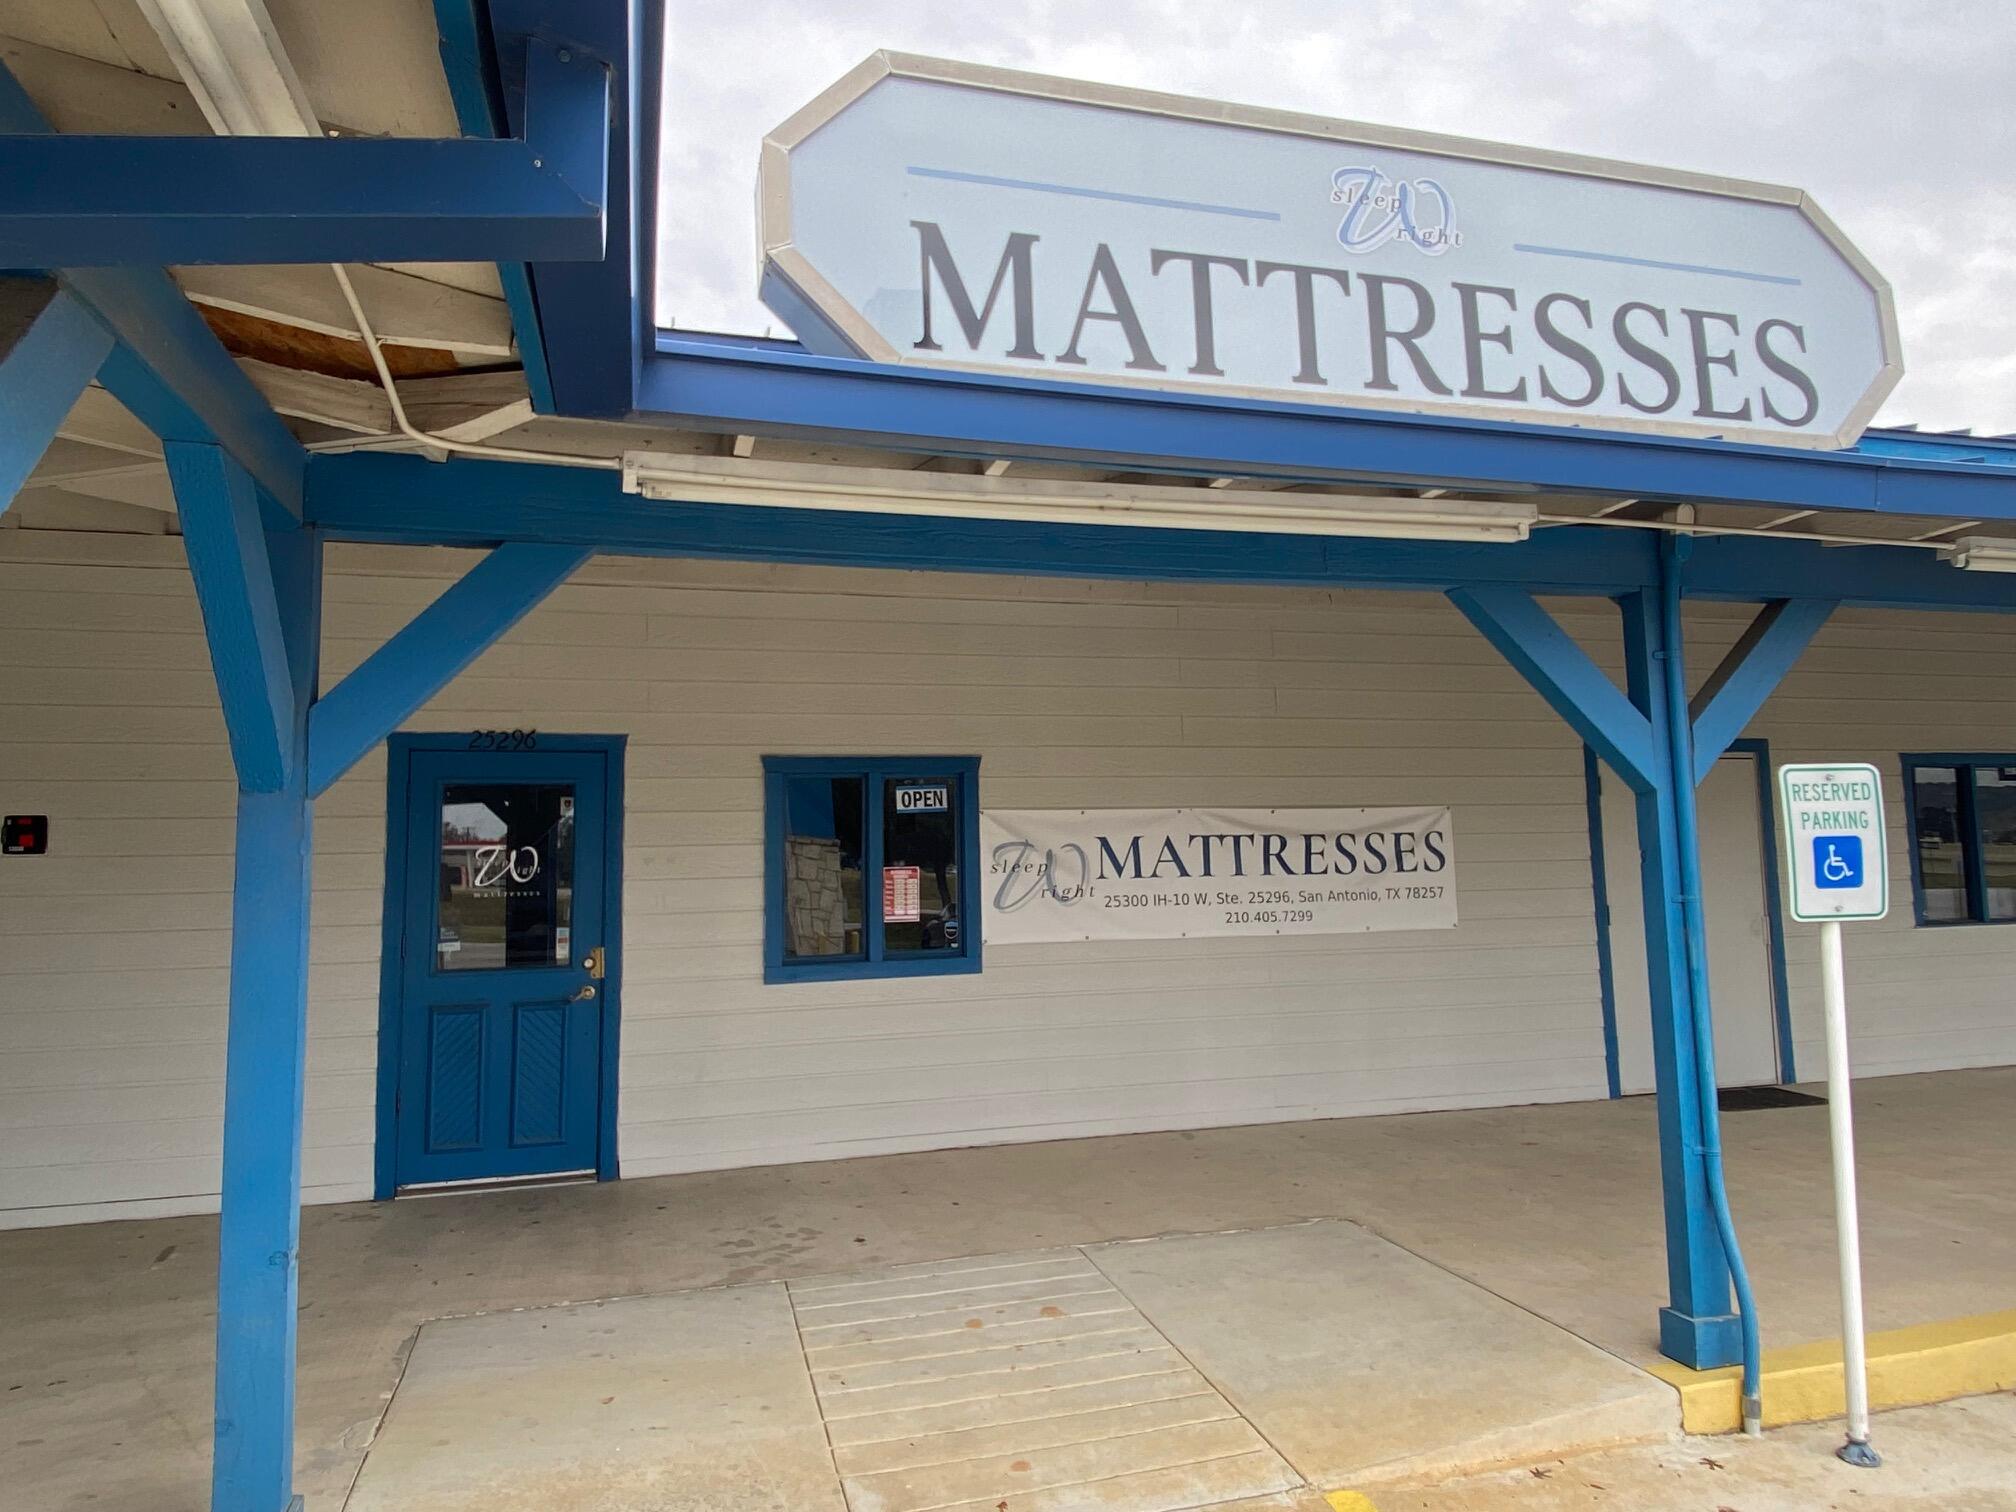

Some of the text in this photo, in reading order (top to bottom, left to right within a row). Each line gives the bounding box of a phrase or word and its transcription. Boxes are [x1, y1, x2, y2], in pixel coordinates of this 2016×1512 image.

[1332, 187, 1402, 214] sleep
[909, 219, 1819, 428] MATTRESSES
[468, 728, 537, 750] 25296
[901, 790, 944, 808] OPEN
[1792, 782, 1871, 802] RESERVED
[1801, 811, 1869, 830] PARKING
[1095, 830, 1447, 880] MATTRESSES
[990, 859, 1048, 877] sleep
[1040, 884, 1097, 902] right
[1104, 886, 1444, 908] 25300 IH-10 W, Ste. 25296, San Antonio, TX 78257
[1225, 910, 1313, 924] 210.405.7299
